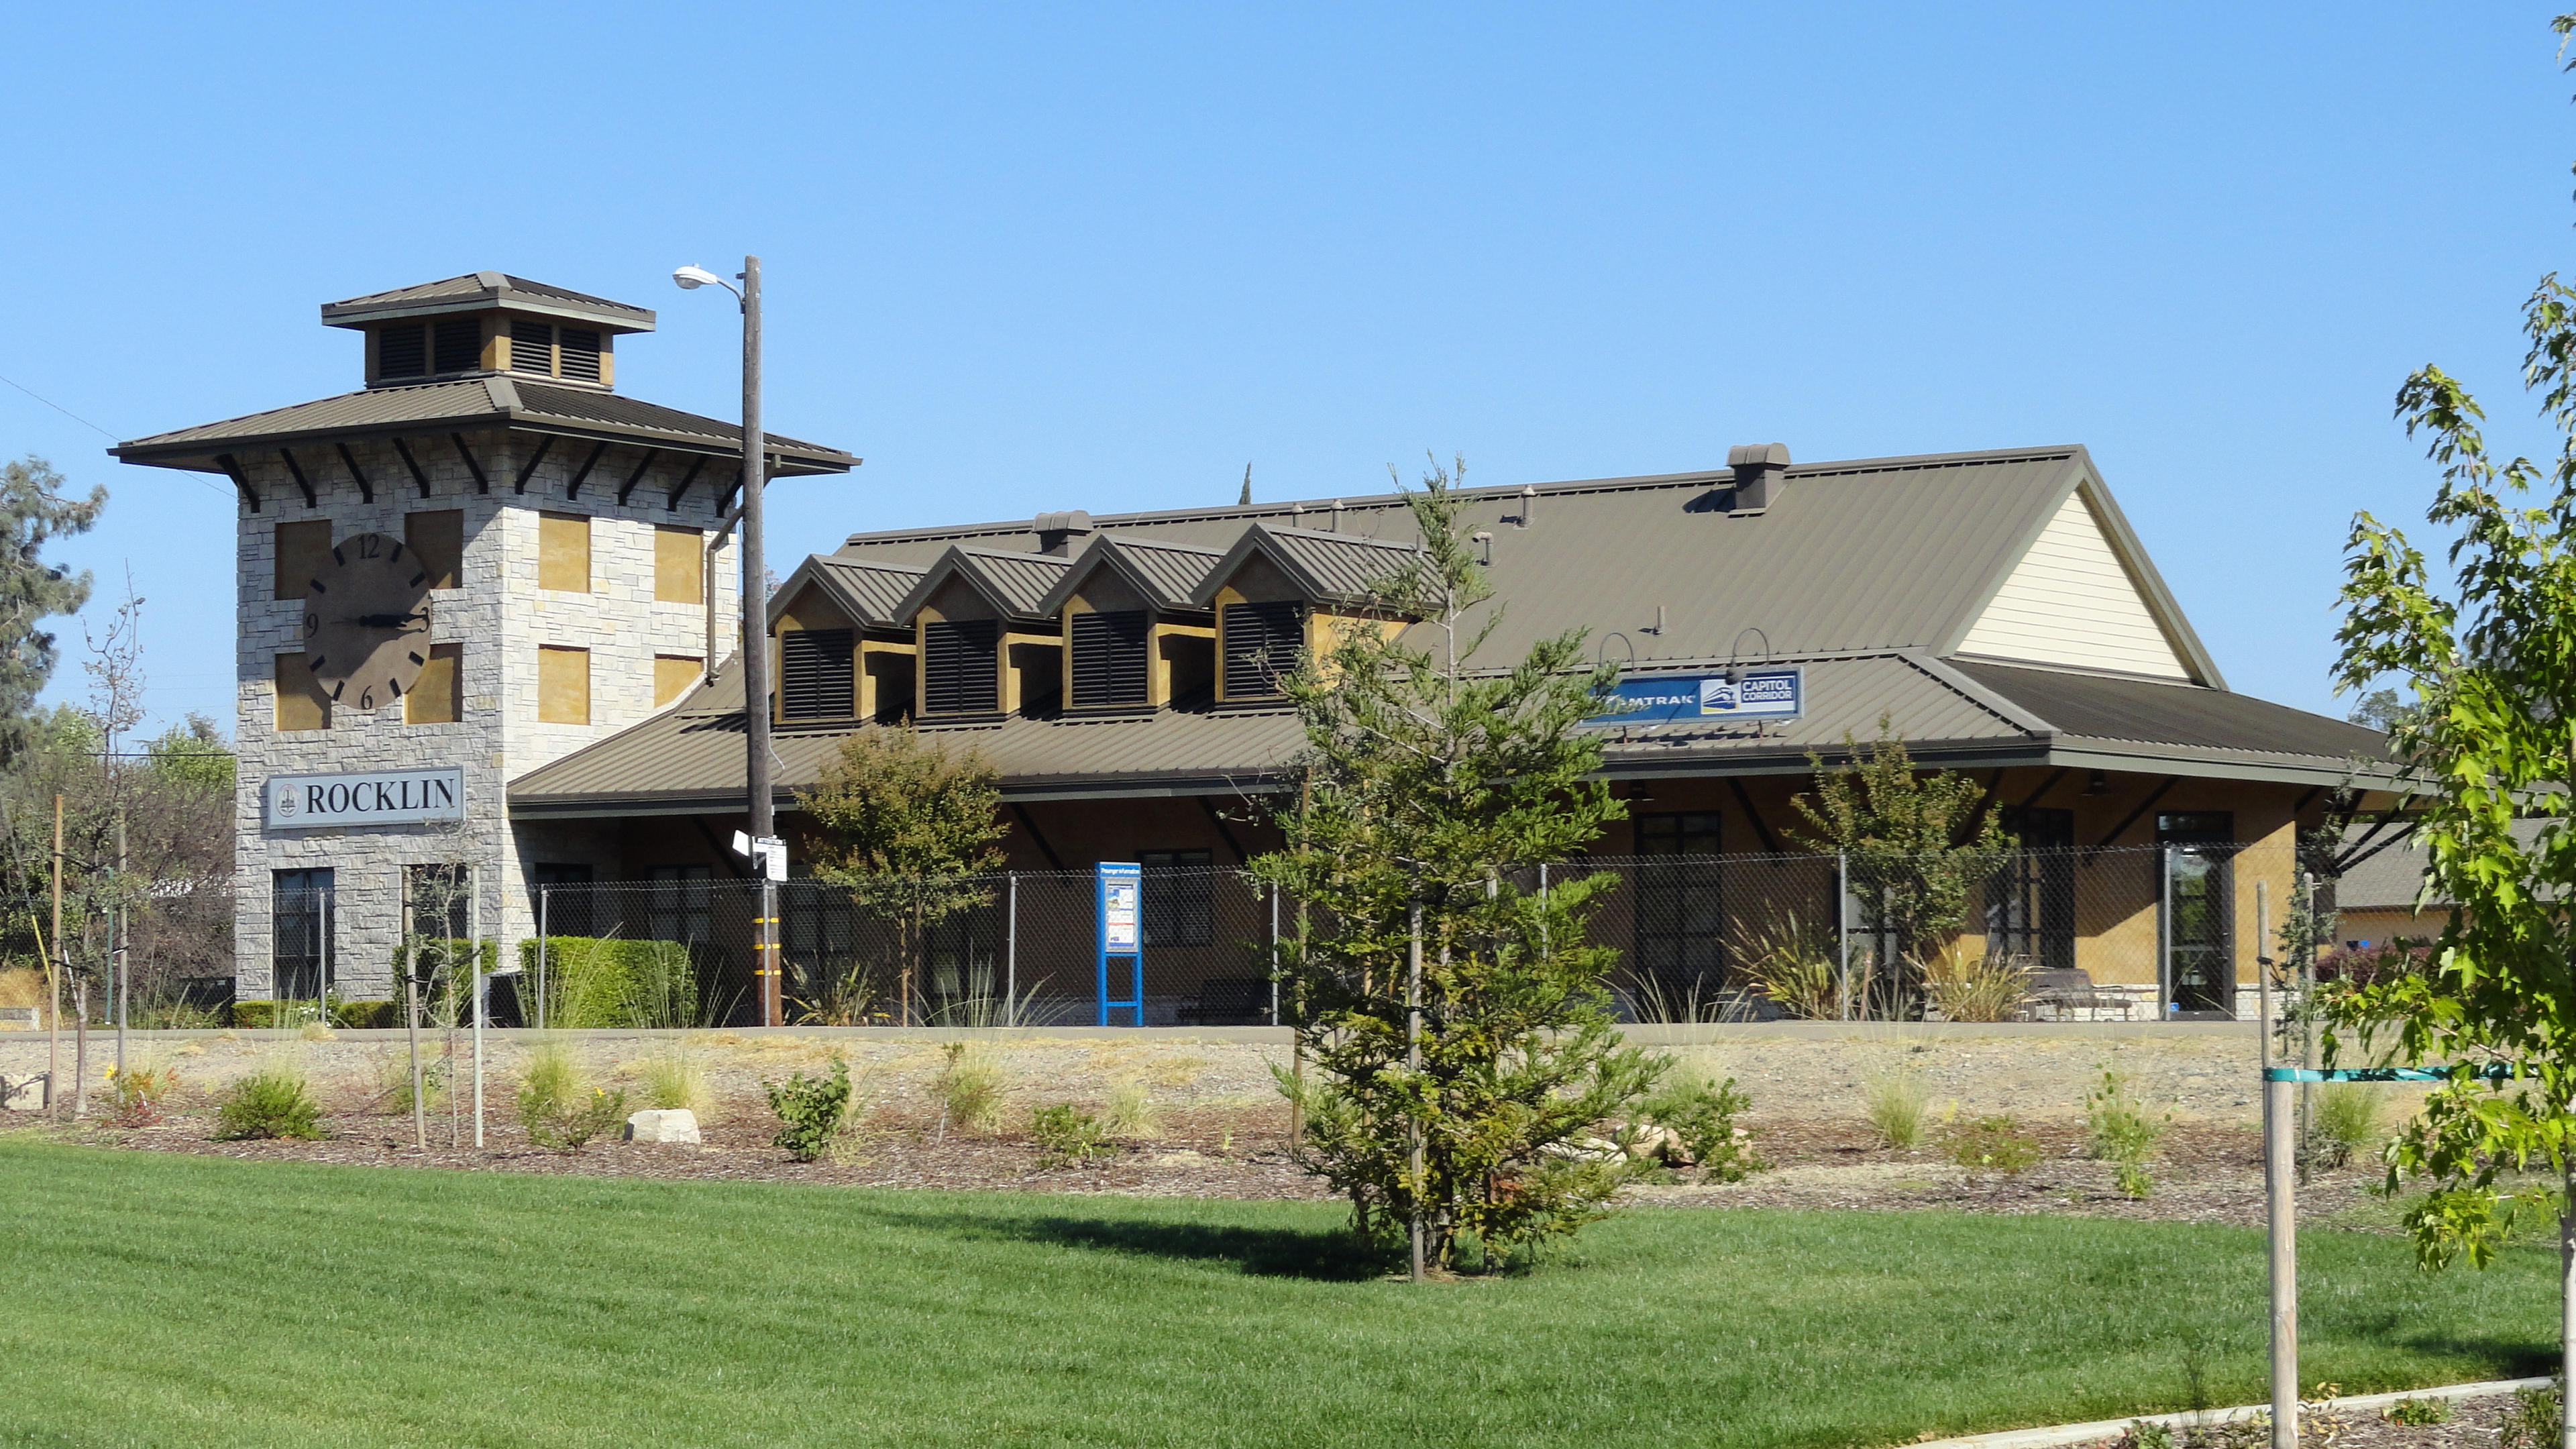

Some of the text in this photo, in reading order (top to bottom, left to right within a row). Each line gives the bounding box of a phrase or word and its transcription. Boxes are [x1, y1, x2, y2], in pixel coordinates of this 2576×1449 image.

[358, 534, 380, 559] 12
[306, 613, 319, 638] 9
[360, 685, 373, 710] 6
[1742, 680, 1792, 692] CAPITOL
[1742, 691, 1792, 701] CORRIDOR
[305, 778, 455, 814] ROCKLIN
